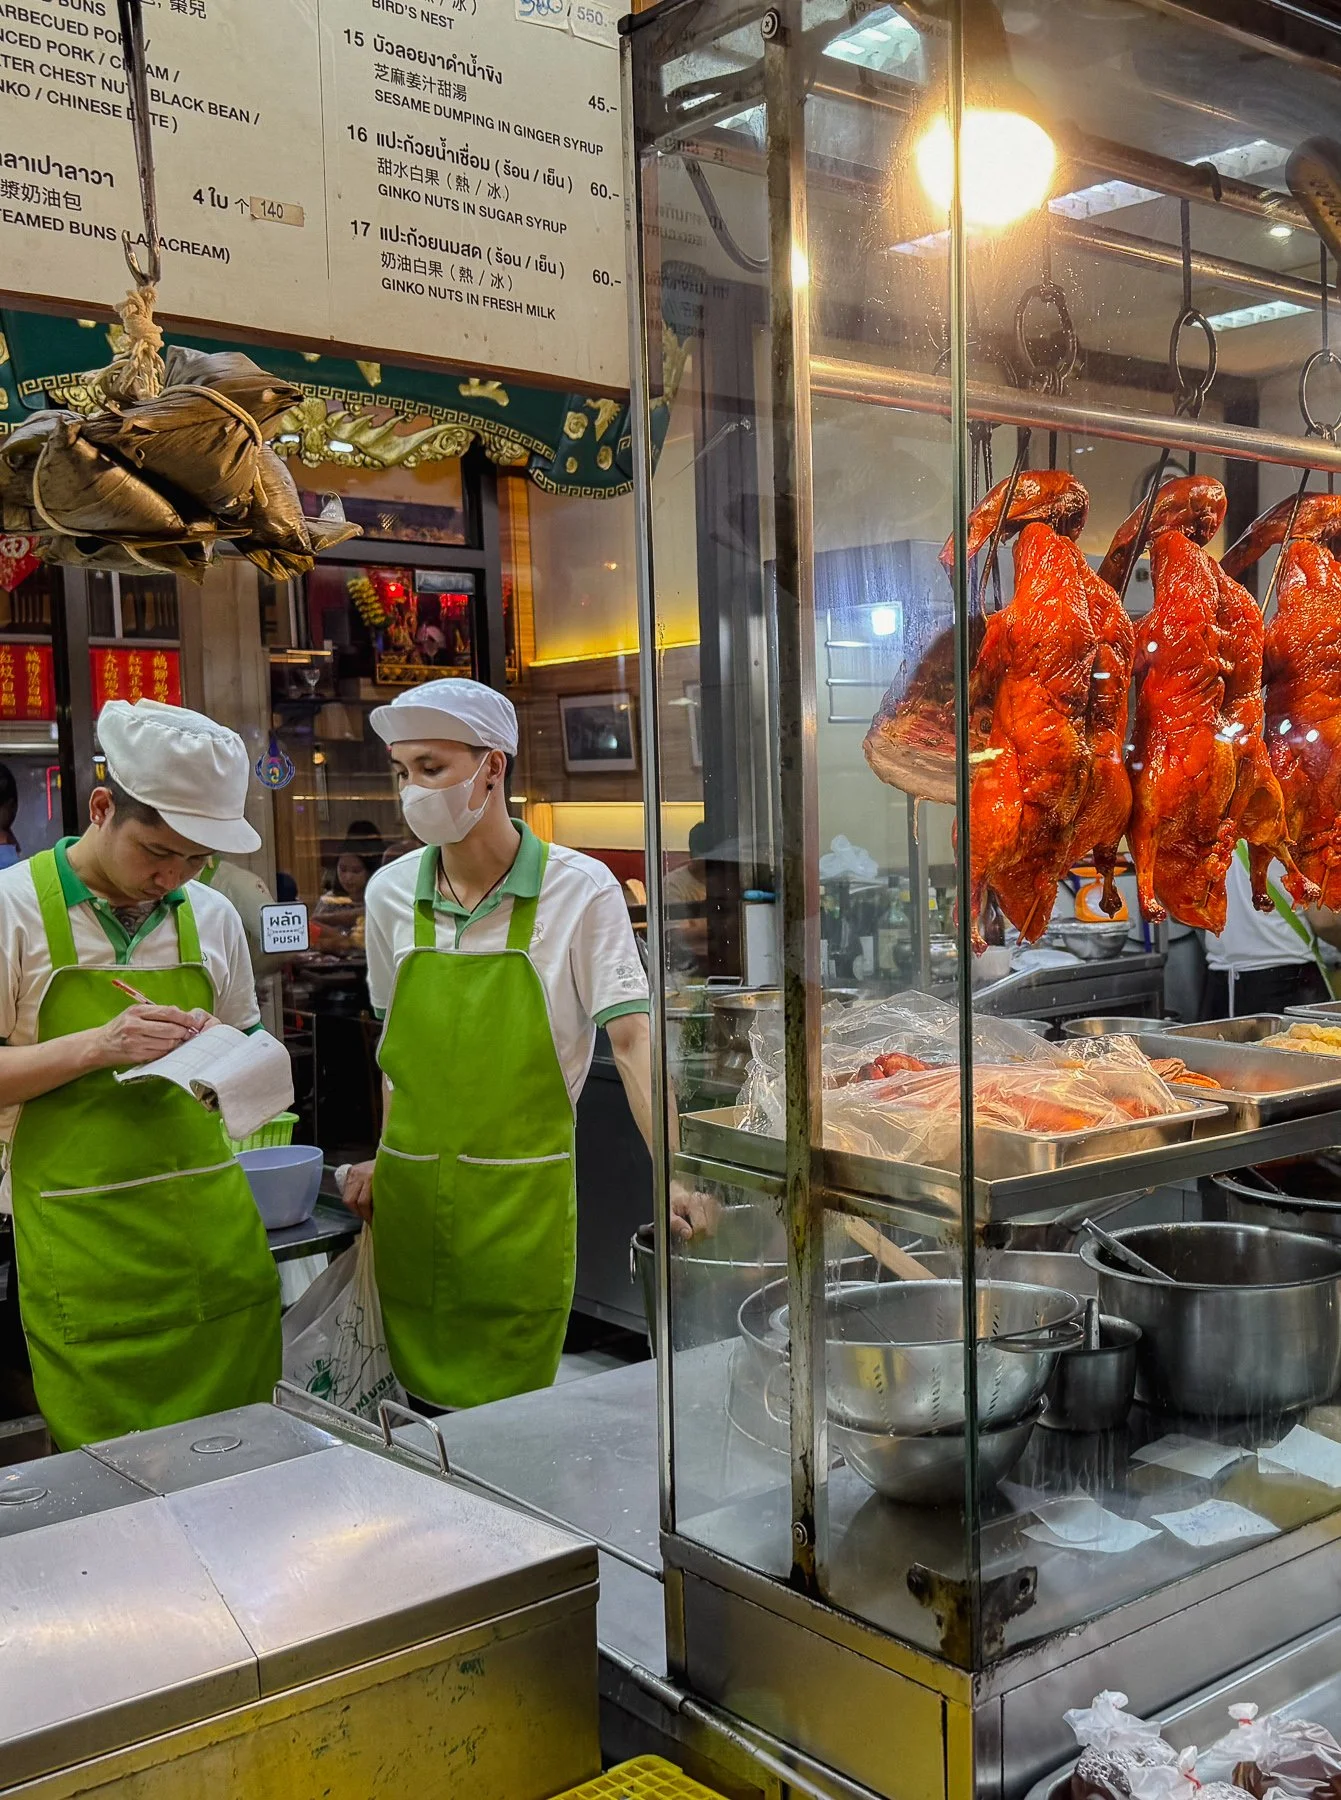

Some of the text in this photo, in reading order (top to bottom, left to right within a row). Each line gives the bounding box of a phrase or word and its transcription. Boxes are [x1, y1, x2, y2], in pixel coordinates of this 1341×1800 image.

[420, 9, 455, 30] NEST
[343, 28, 365, 48] 15
[47, 40, 95, 64] PORK
[110, 55, 169, 81] CAM
[373, 33, 502, 85] บัวลอยงาดำน้ำขิง
[0, 54, 35, 75] TER
[39, 63, 96, 88] CHEST
[101, 77, 129, 95] NU
[150, 88, 205, 113] BLACK
[208, 102, 250, 124] BEAN
[47, 90, 122, 119] CHINESE
[588, 95, 618, 113] 45.-
[374, 88, 604, 156] SESAME DUMPING IN GINGER SYRUP
[347, 124, 368, 143] 16
[192, 188, 204, 205] 4
[208, 187, 229, 209] ใบ
[590, 181, 620, 200] 60.-
[261, 200, 284, 219] 140
[378, 183, 567, 234] GINKO NUTS IN SUGAR SYRUP
[0, 207, 65, 232] EAMED
[69, 220, 117, 241] BUNS
[350, 219, 371, 237] 17
[592, 268, 622, 287] 60.-
[381, 277, 556, 320] GINKO NUTS IN FRESH MILK
[270, 911, 302, 927] ผลัก
[273, 935, 300, 945] PUSH
